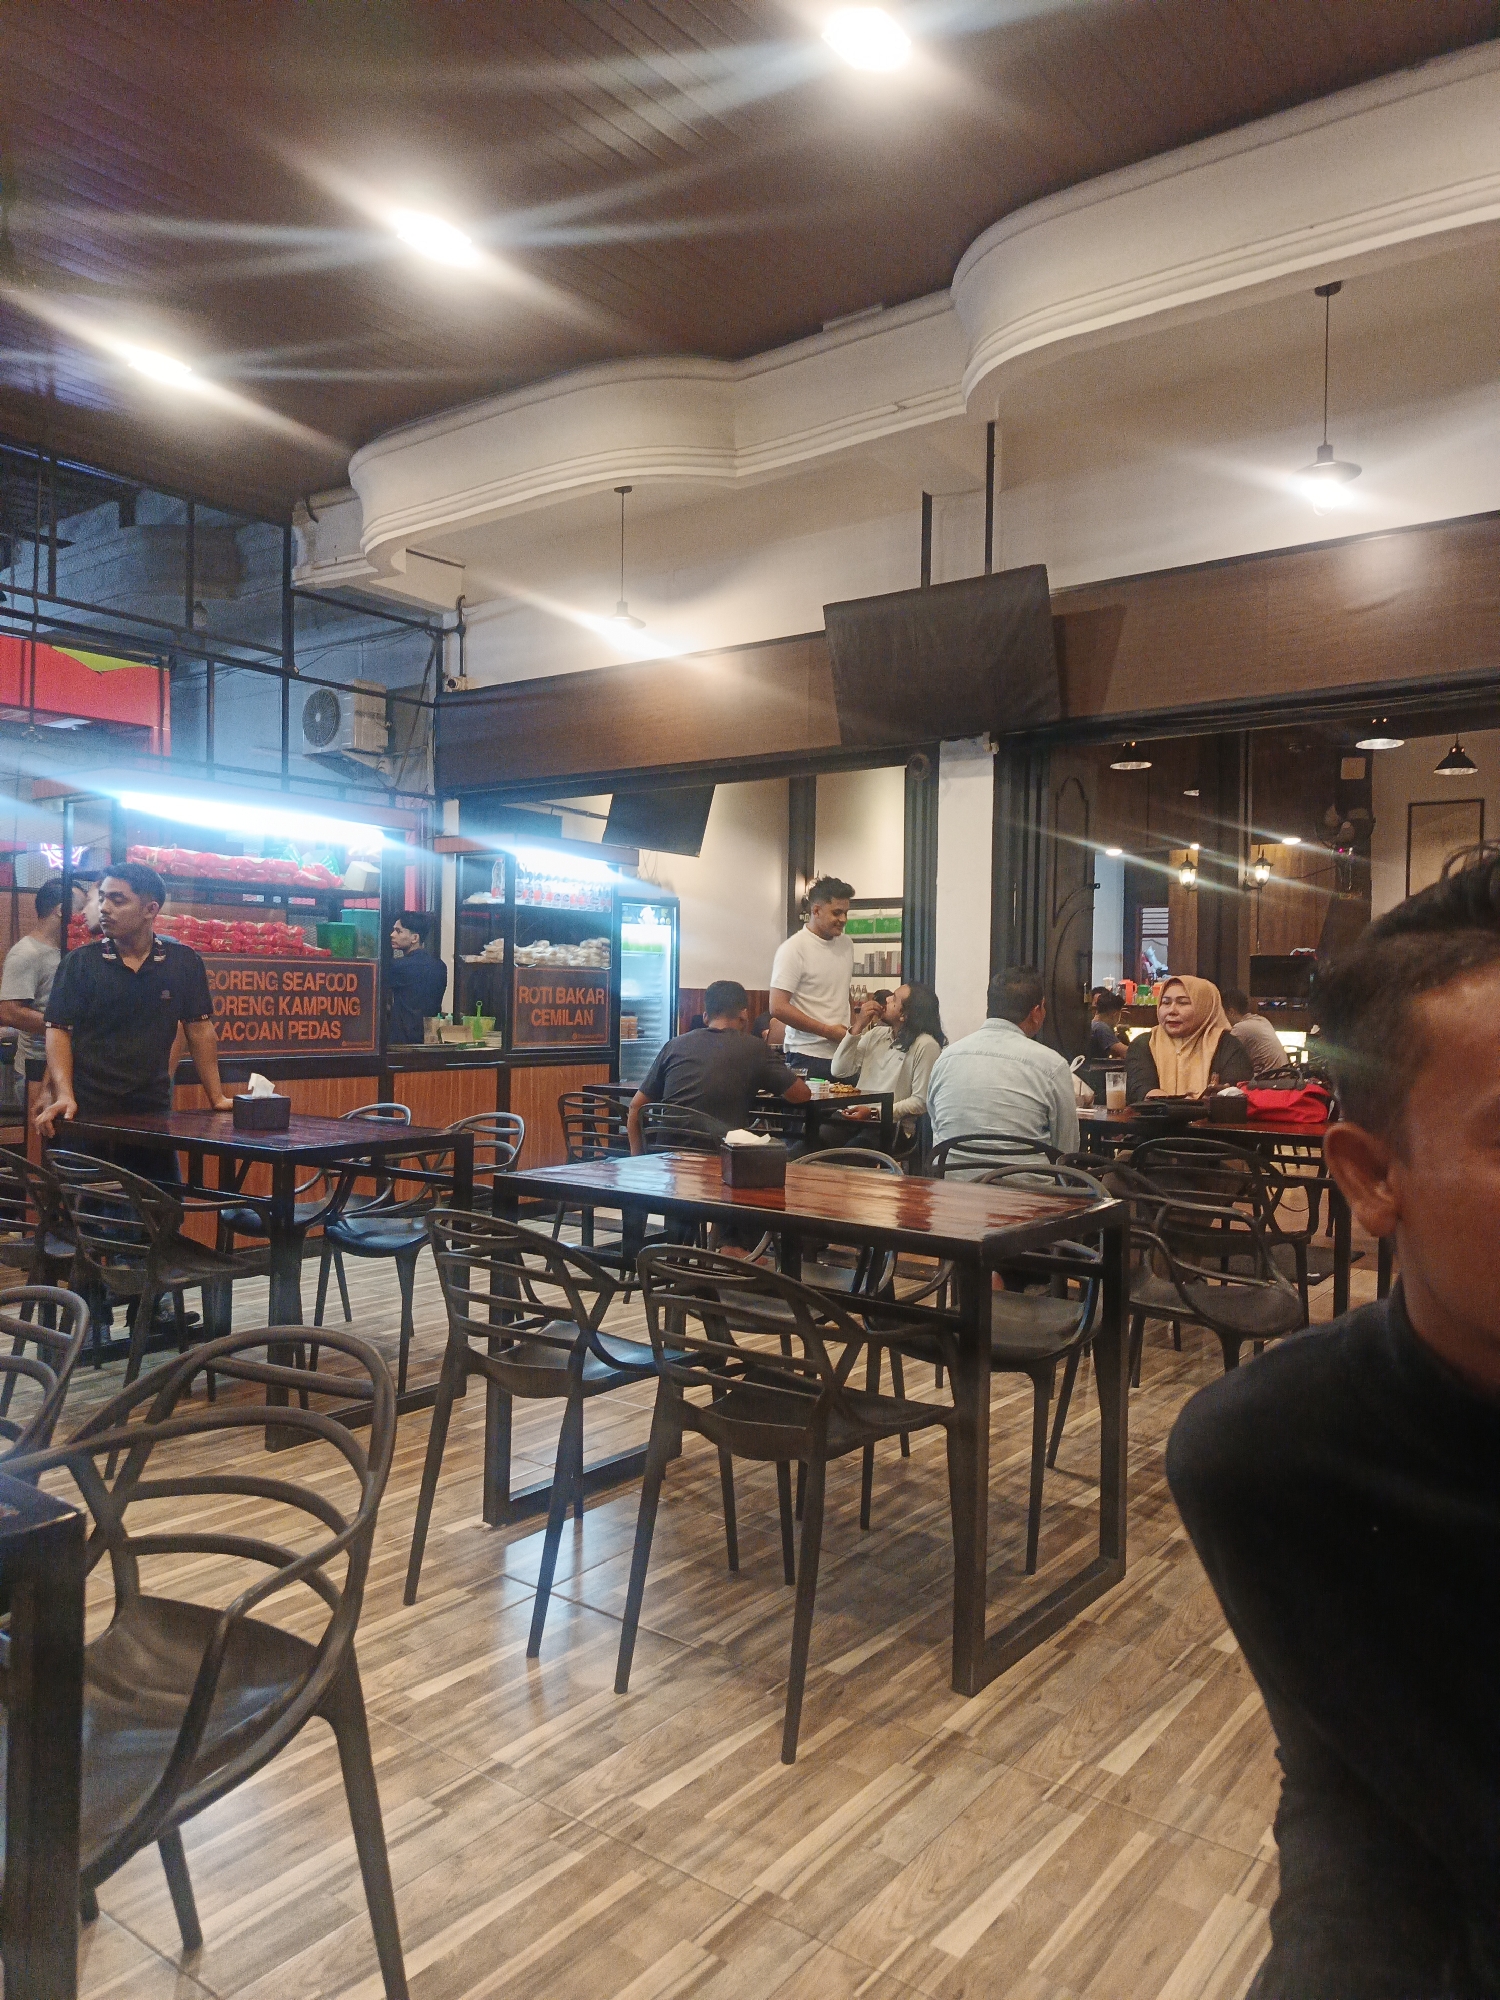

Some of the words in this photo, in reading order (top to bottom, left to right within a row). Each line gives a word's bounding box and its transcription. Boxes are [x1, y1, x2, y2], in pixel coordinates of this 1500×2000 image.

[282, 971, 358, 992] SEAFOOD
[213, 995, 275, 1016] ORENG
[278, 997, 361, 1016] KAMPUNG
[518, 986, 553, 1004] ROTI
[555, 987, 605, 1005] BAKAR
[531, 1009, 594, 1027] CEMILAN
[288, 1020, 342, 1040] PEDAS
